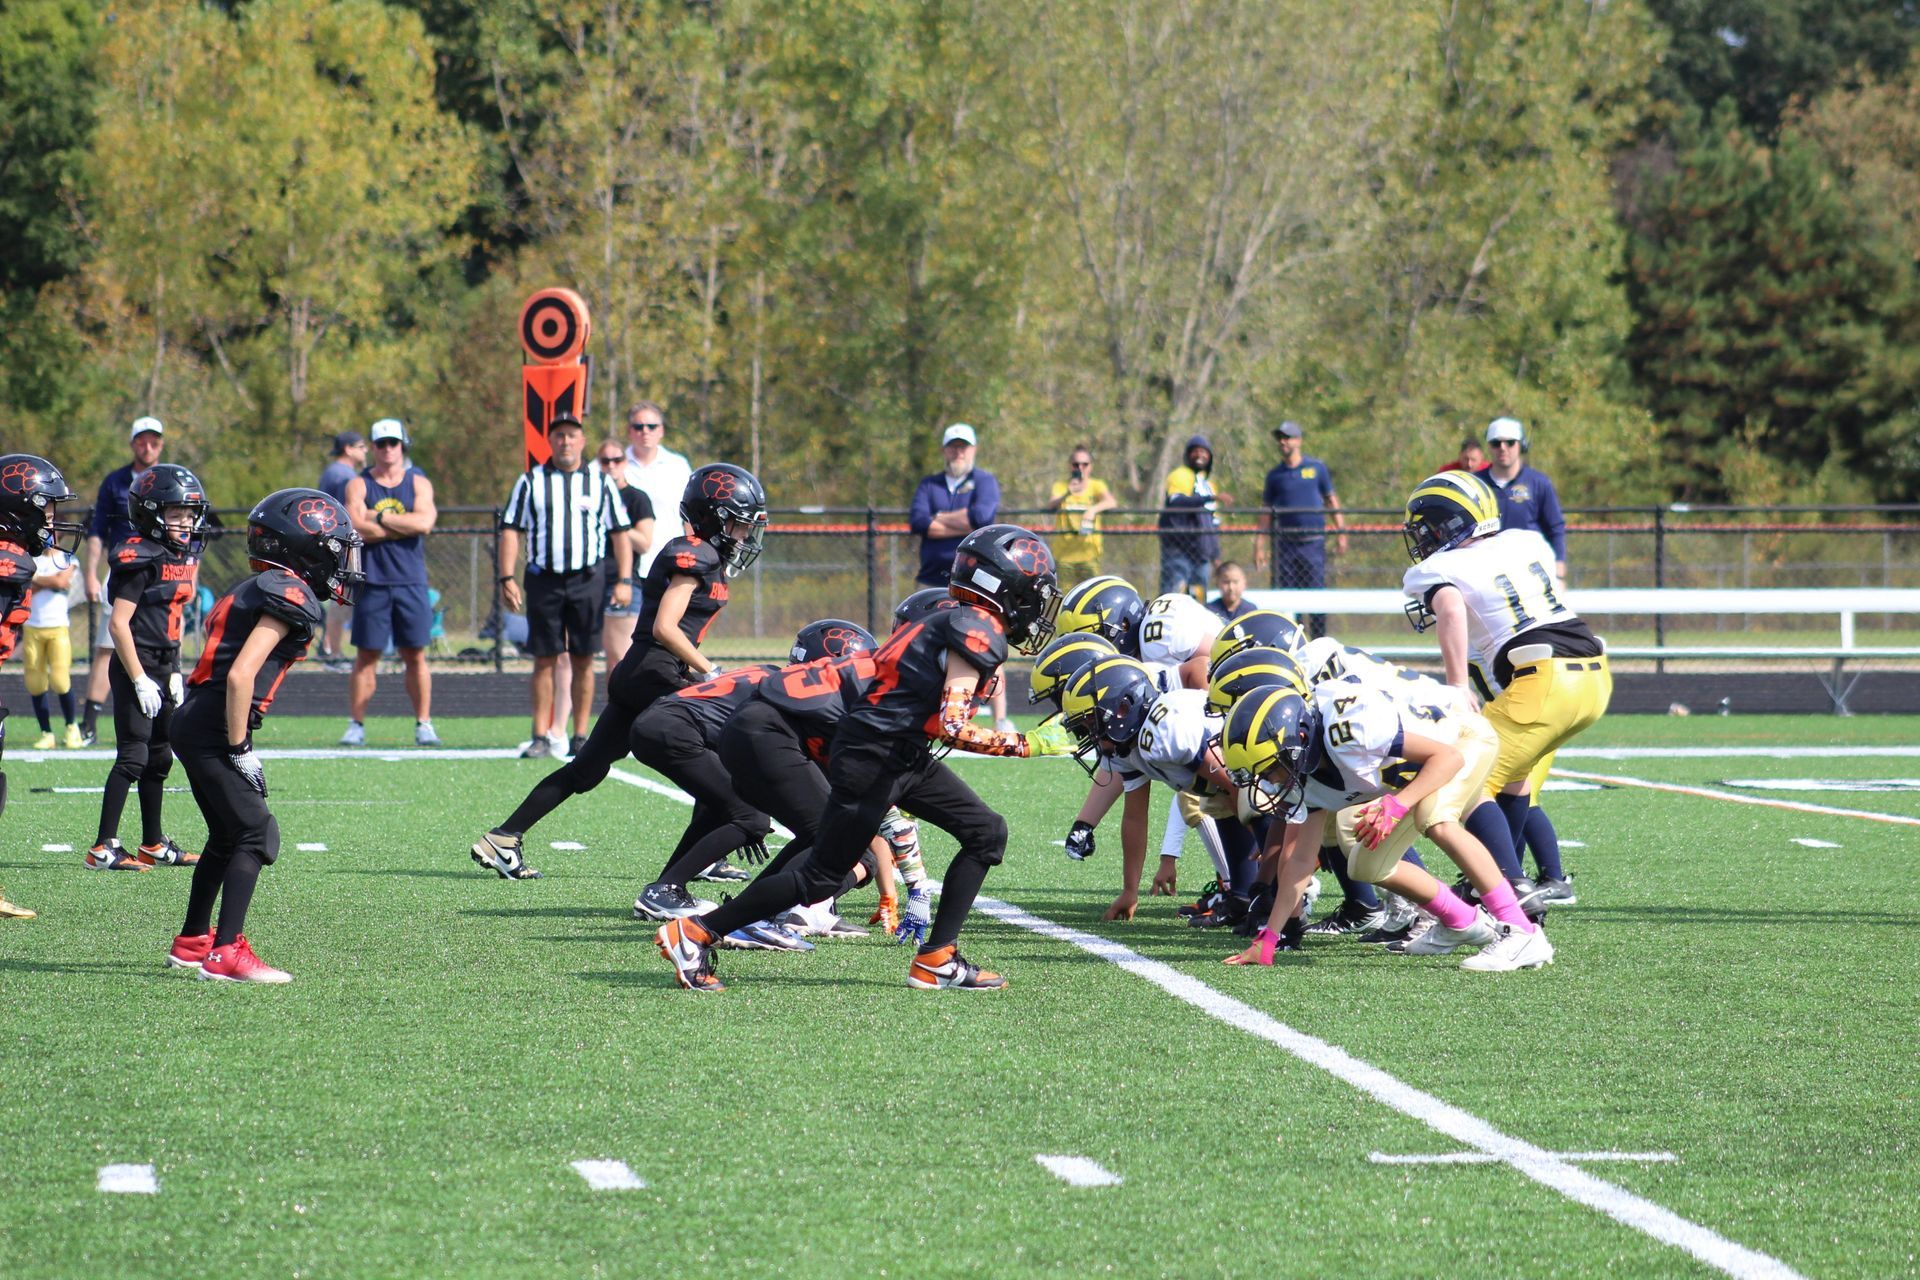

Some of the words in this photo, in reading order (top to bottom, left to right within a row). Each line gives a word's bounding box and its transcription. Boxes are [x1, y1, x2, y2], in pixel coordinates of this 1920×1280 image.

[1144, 599, 1172, 643] 83
[1494, 561, 1567, 634] 11
[1139, 703, 1169, 752] 66
[1328, 695, 1357, 747] 24
